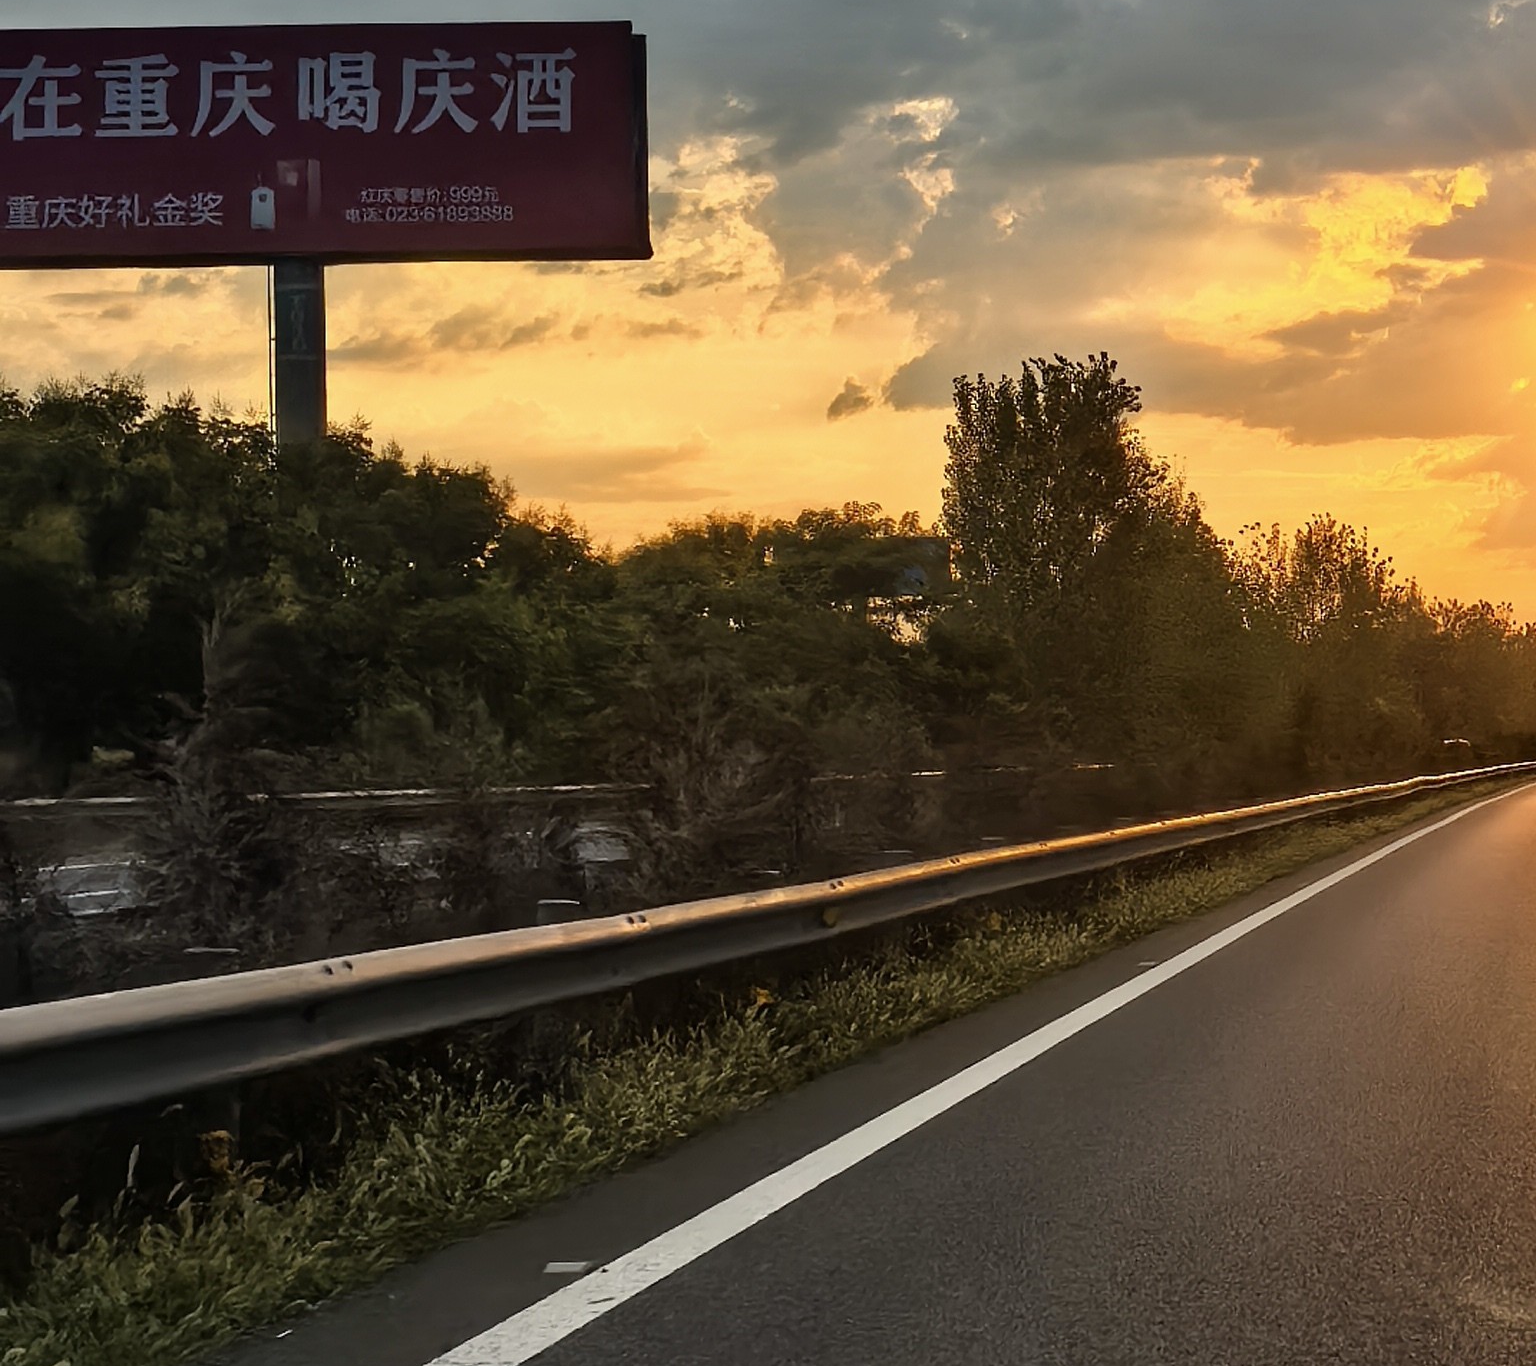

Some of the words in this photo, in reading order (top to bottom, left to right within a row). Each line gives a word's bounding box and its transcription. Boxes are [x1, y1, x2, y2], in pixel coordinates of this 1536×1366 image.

[0, 48, 577, 140] 在重庆喝庆酒
[4, 192, 225, 229] 重庆好礼金奖
